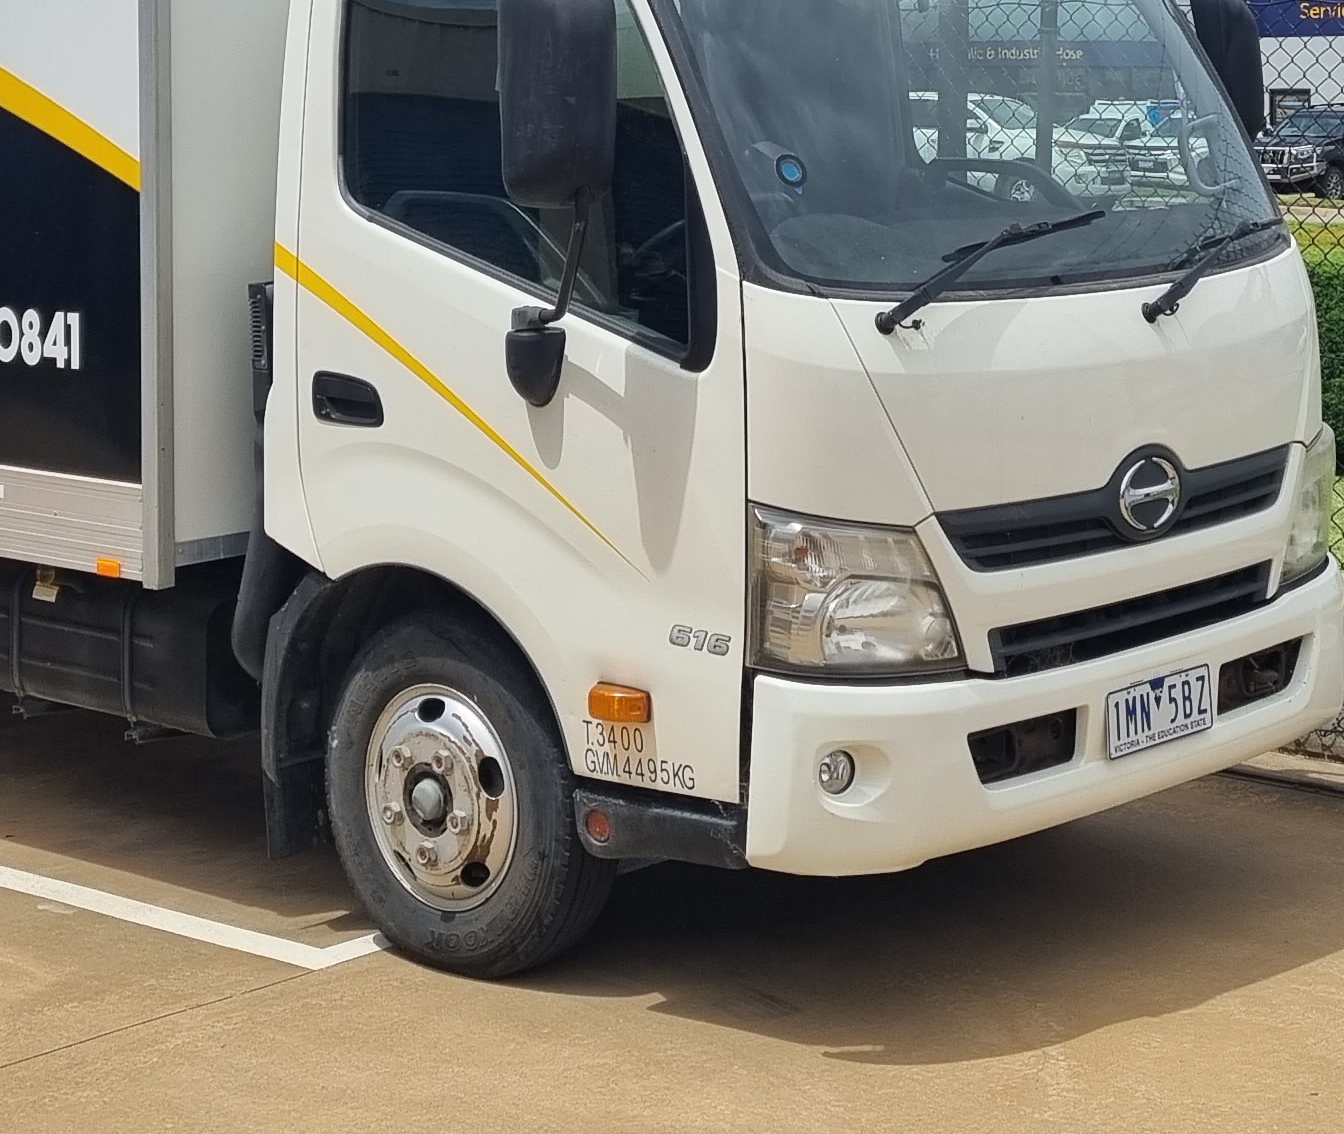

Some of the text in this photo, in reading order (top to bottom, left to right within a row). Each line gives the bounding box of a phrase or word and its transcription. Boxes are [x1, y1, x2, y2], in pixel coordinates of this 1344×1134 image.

[668, 624, 731, 657] 616
[1113, 674, 1208, 742] 1MN 5BZ
[582, 719, 644, 754] T.3400
[1114, 739, 1141, 754] VICTORIA
[1145, 732, 1157, 745] THE
[1157, 724, 1190, 739] EDUCATION
[1190, 717, 1207, 730] STATE
